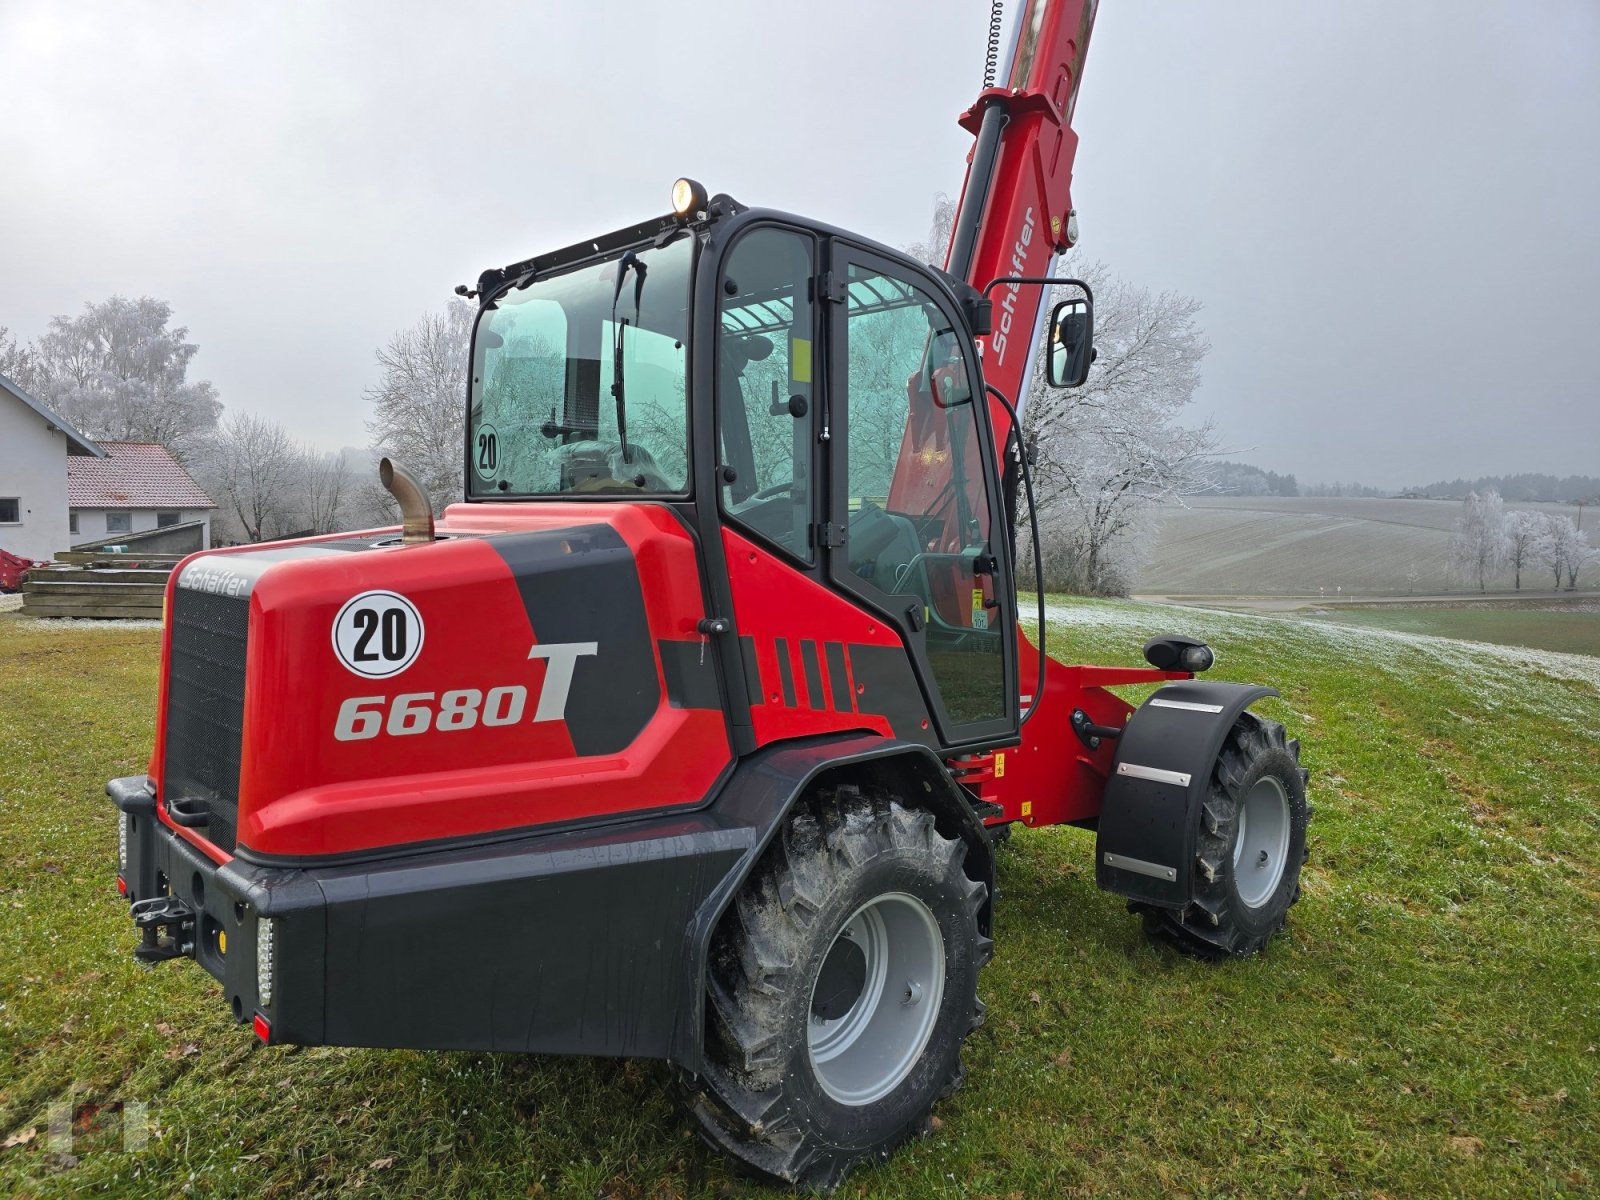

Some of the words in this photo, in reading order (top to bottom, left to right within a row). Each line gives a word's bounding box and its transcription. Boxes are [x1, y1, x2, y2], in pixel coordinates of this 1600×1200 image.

[992, 207, 1034, 366] Schäffer
[479, 433, 496, 469] 20
[180, 567, 248, 596] Schäffer
[353, 608, 407, 662] 20
